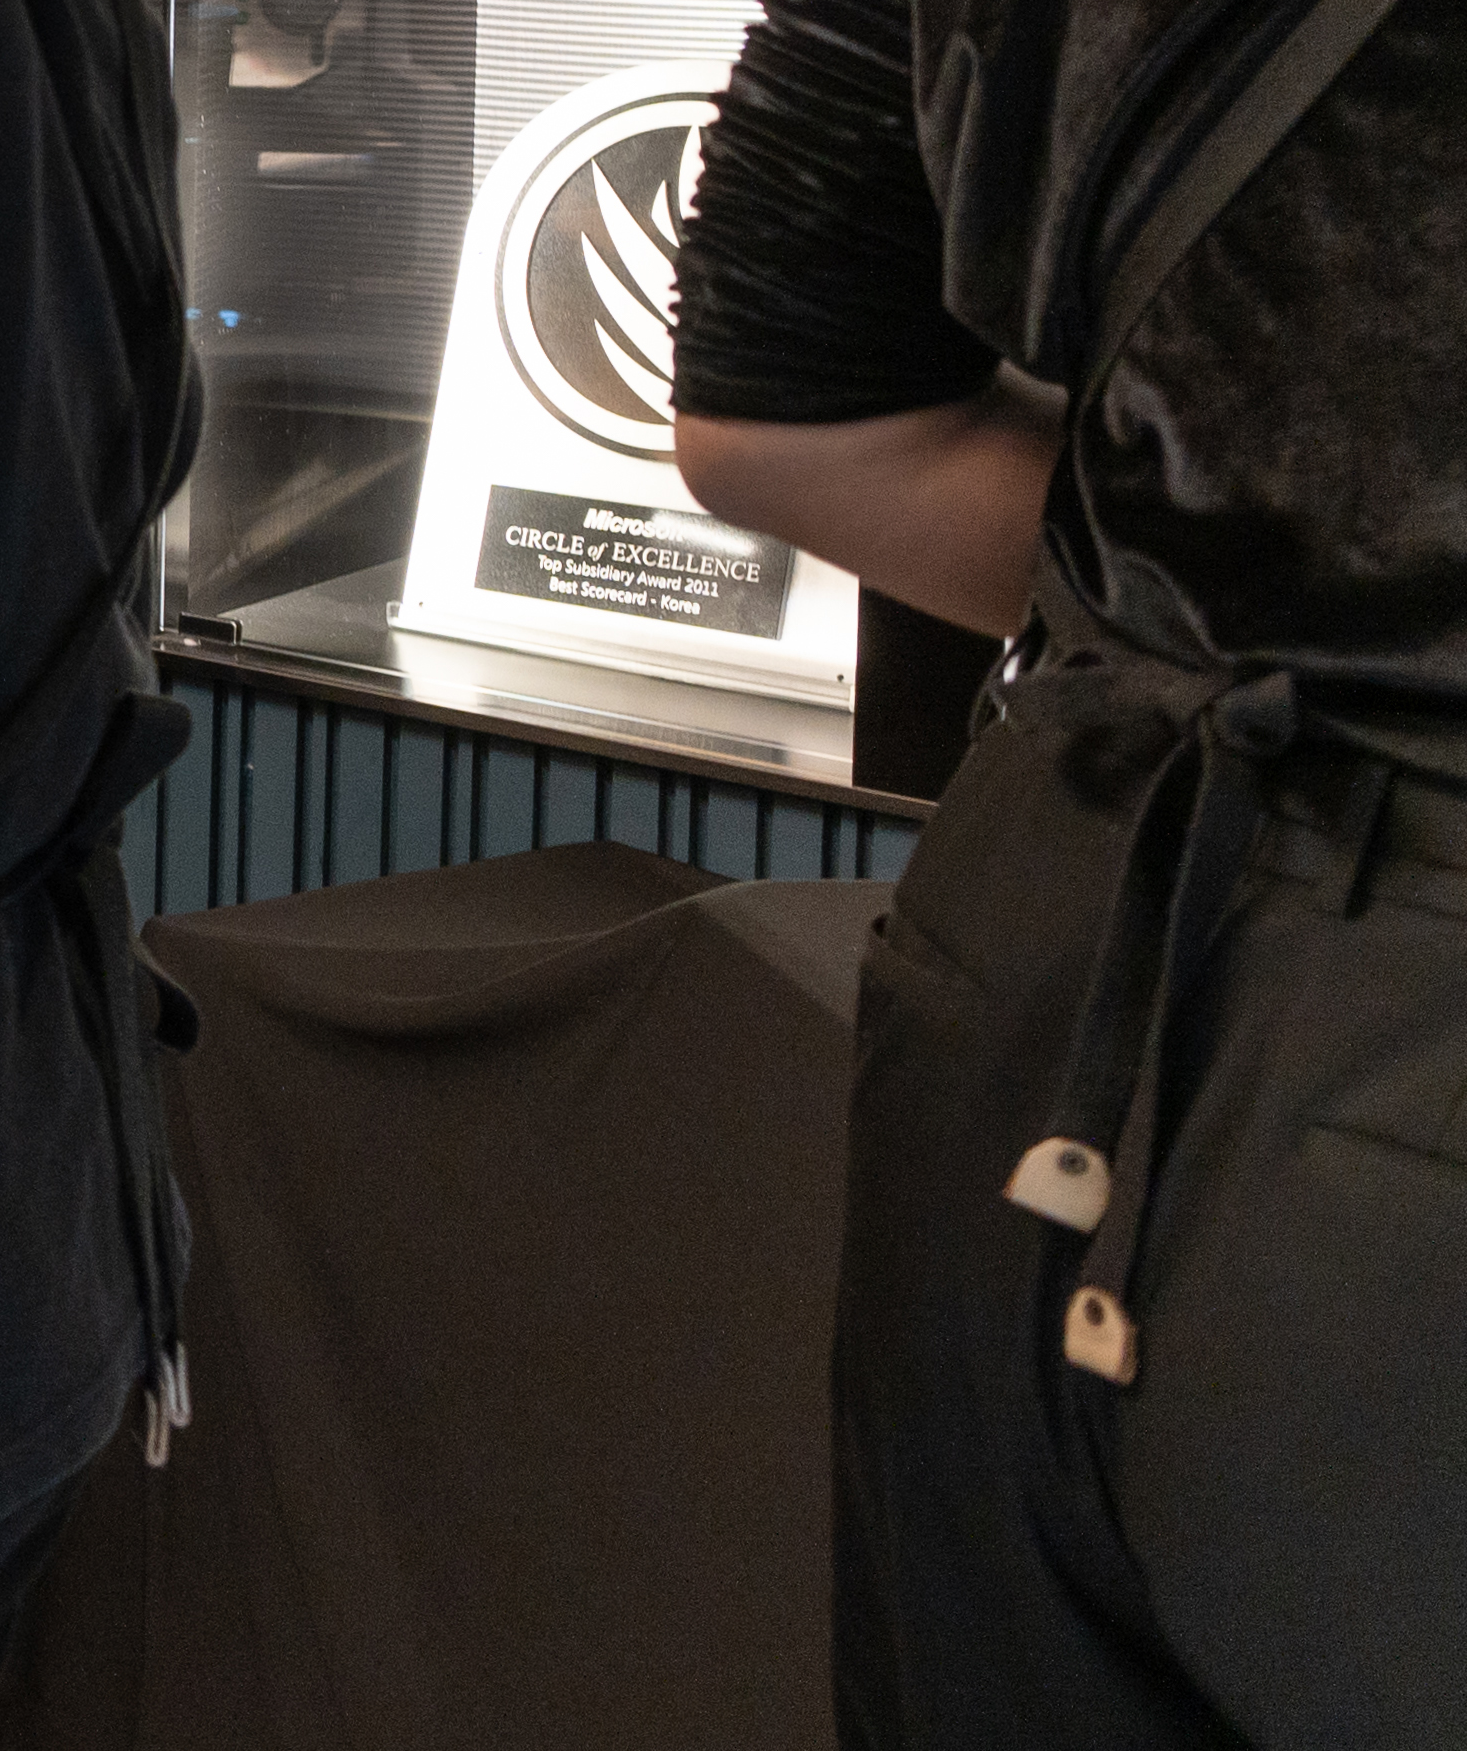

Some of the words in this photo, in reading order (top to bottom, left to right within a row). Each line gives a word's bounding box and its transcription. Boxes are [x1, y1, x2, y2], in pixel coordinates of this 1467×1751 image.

[505, 525, 585, 556] CIRCLE
[587, 542, 609, 562] of
[612, 542, 761, 584] EXCELLENCE
[538, 554, 563, 575] Top
[564, 560, 635, 589] Subsidiary
[636, 573, 682, 592] Award
[683, 577, 720, 598] 2011
[549, 576, 579, 597] Best
[580, 581, 648, 607] Scorecard
[660, 595, 701, 616] Korea
